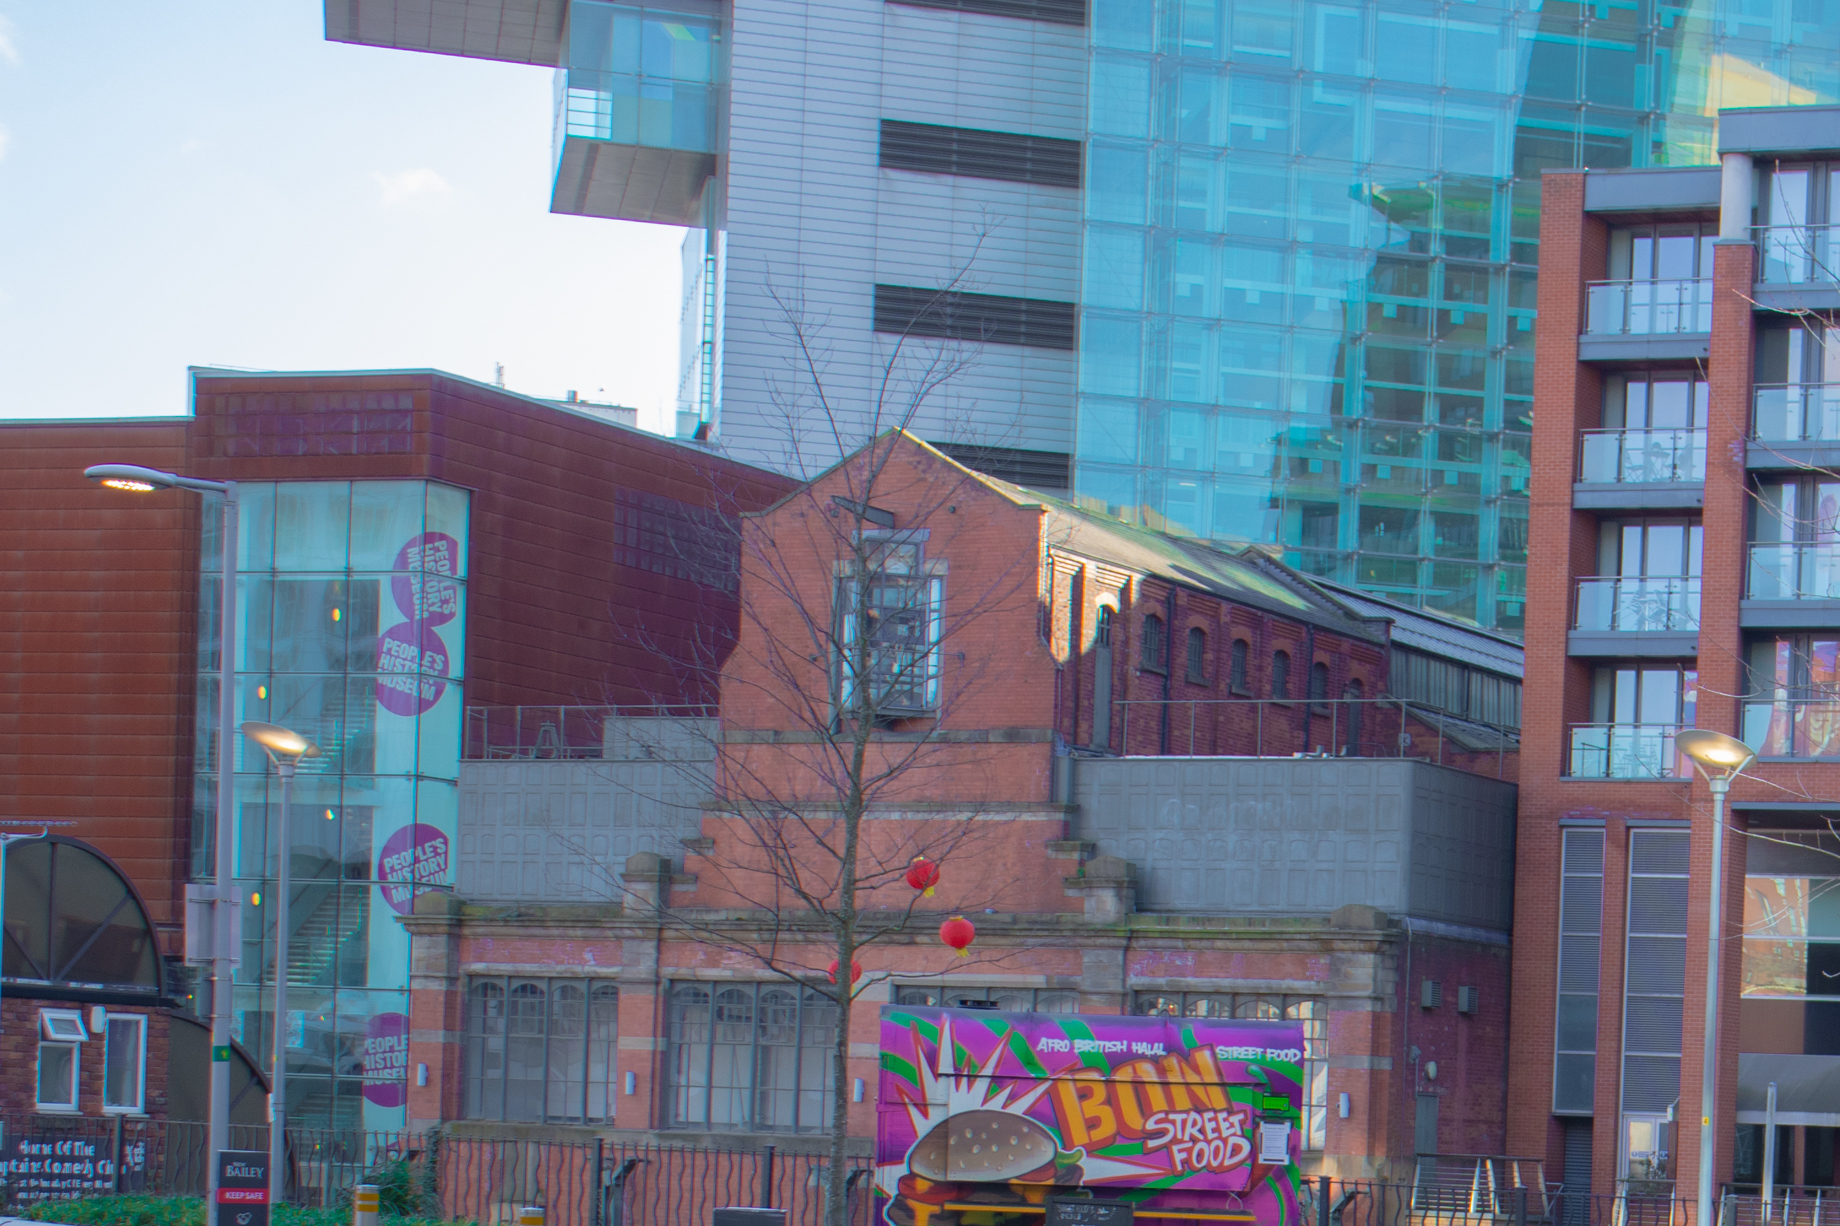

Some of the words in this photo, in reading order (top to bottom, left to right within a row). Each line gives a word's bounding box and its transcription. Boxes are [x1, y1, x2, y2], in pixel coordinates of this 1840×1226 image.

[425, 543, 443, 612] HISORY
[384, 838, 446, 873] PEOPLE'S
[1037, 1037, 1070, 1053] AFRO
[1074, 1039, 1127, 1053] BRITISH
[1131, 1041, 1167, 1056] HALAL
[1216, 1046, 1264, 1060] STREET
[1266, 1048, 1302, 1062] FOOD
[1145, 1110, 1246, 1149] STREET
[20, 1140, 53, 1154] Home
[73, 1141, 95, 1156] The
[1171, 1136, 1251, 1172] FOOD
[44, 1158, 94, 1178] Comedy
[226, 1165, 264, 1178] BAILEY
[226, 1191, 245, 1200] KEEP
[246, 1192, 264, 1200] SAFE
